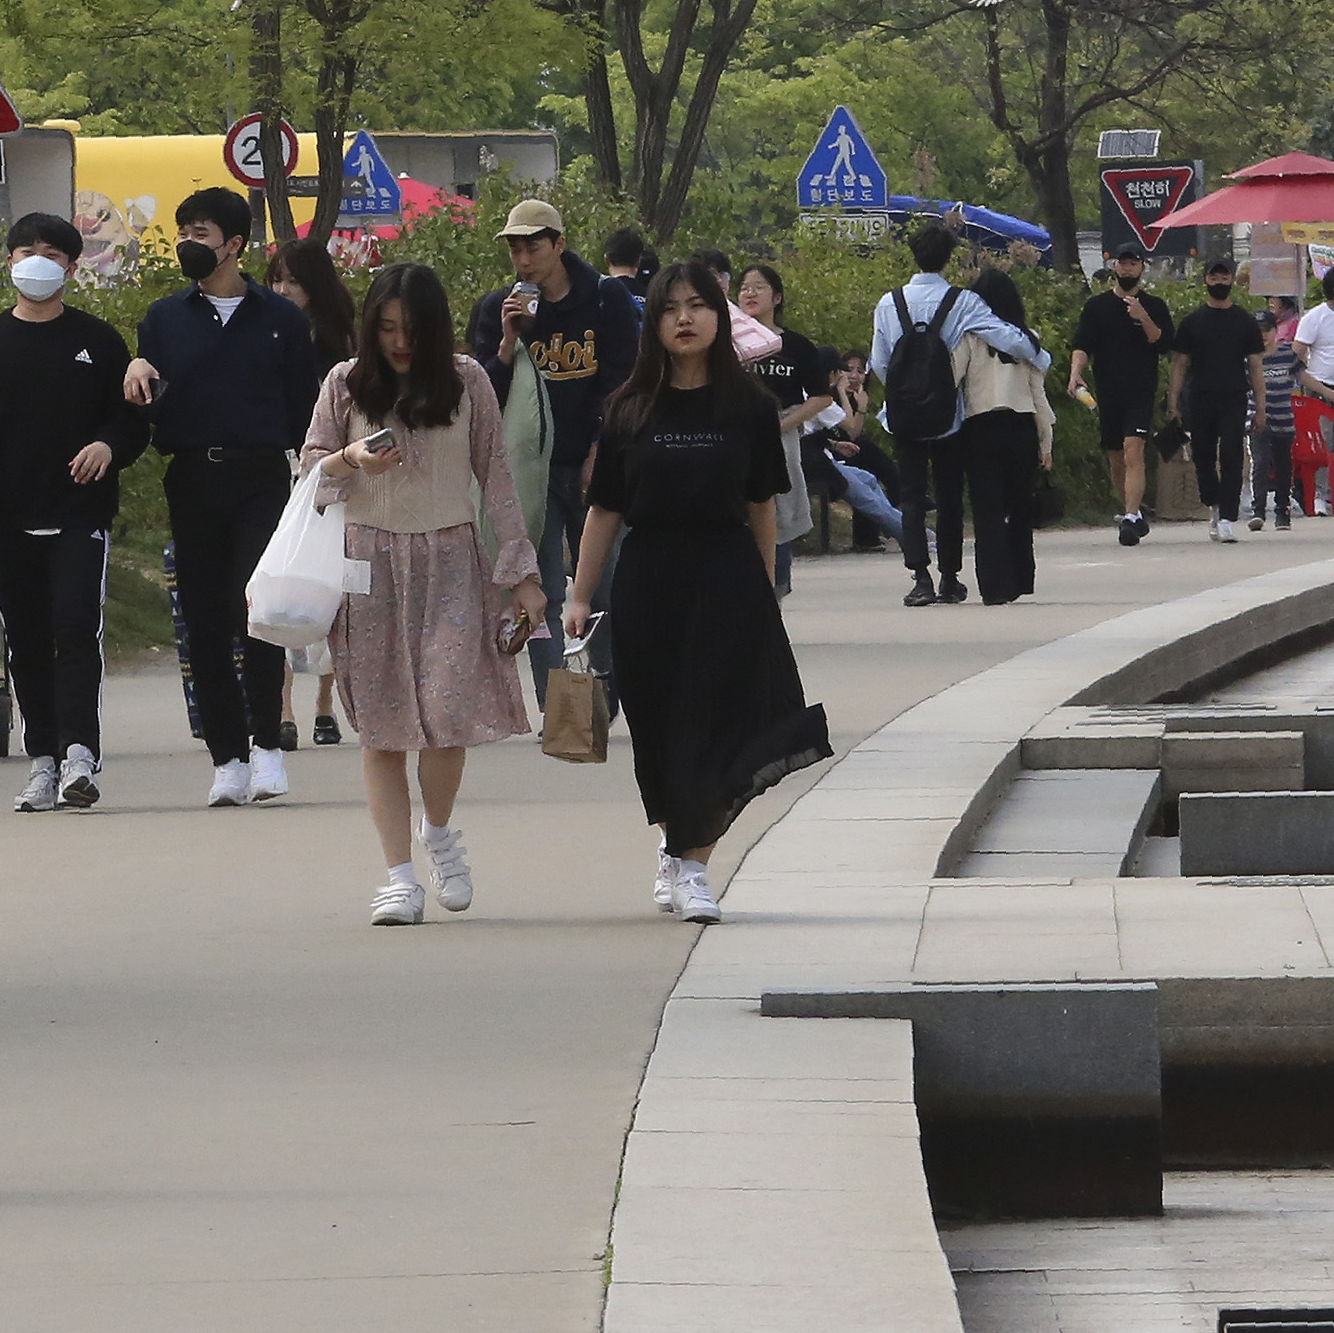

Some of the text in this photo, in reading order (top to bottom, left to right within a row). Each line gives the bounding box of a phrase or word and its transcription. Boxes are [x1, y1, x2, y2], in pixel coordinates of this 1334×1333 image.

[241, 135, 264, 166] 2
[810, 188, 874, 202] 횡단보도
[1126, 180, 1170, 198] 천천히
[1134, 199, 1162, 208] SLOW
